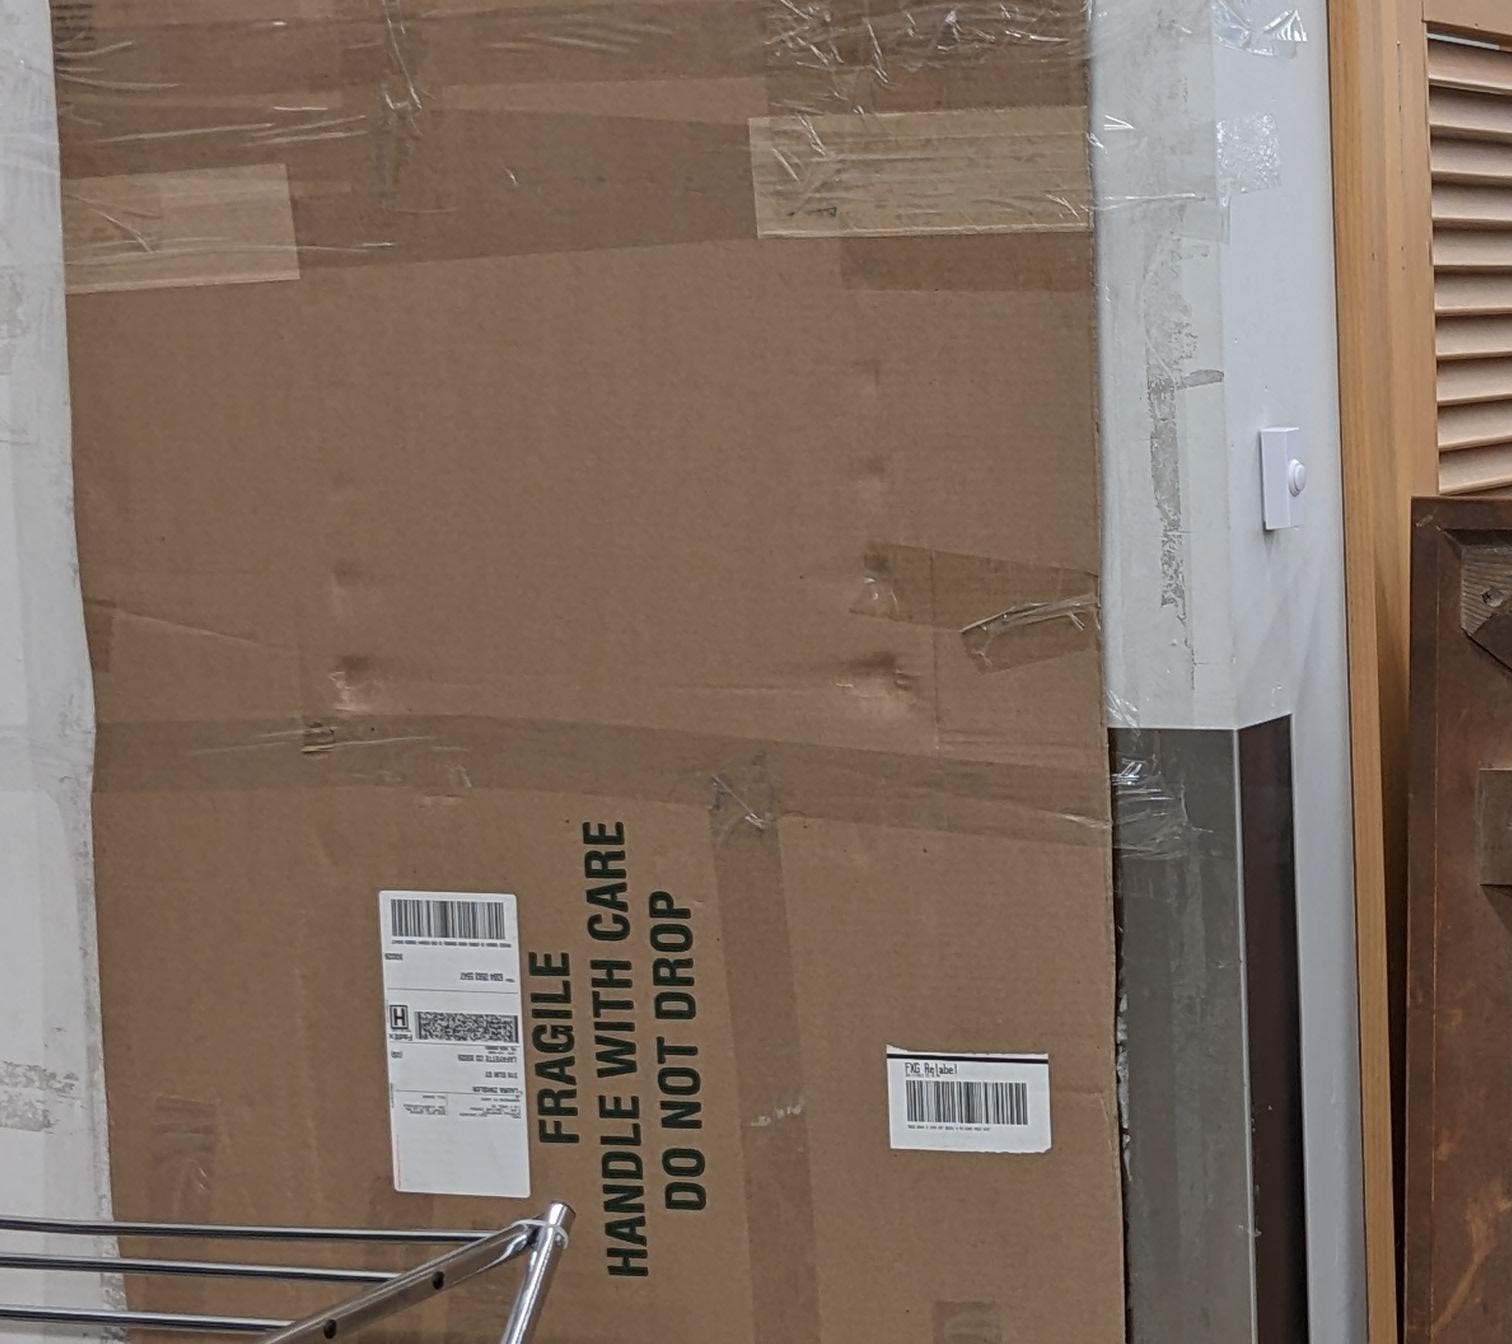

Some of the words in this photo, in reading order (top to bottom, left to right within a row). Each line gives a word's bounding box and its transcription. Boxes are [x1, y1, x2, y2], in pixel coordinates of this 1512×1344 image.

[582, 821, 631, 942] CARE
[649, 890, 697, 1020] DROP
[529, 952, 580, 1144] FRAGILE
[590, 960, 639, 1078] WITH
[656, 1036, 703, 1131] NOT
[600, 1095, 649, 1277] HANDLE
[665, 1147, 707, 1210] DO
